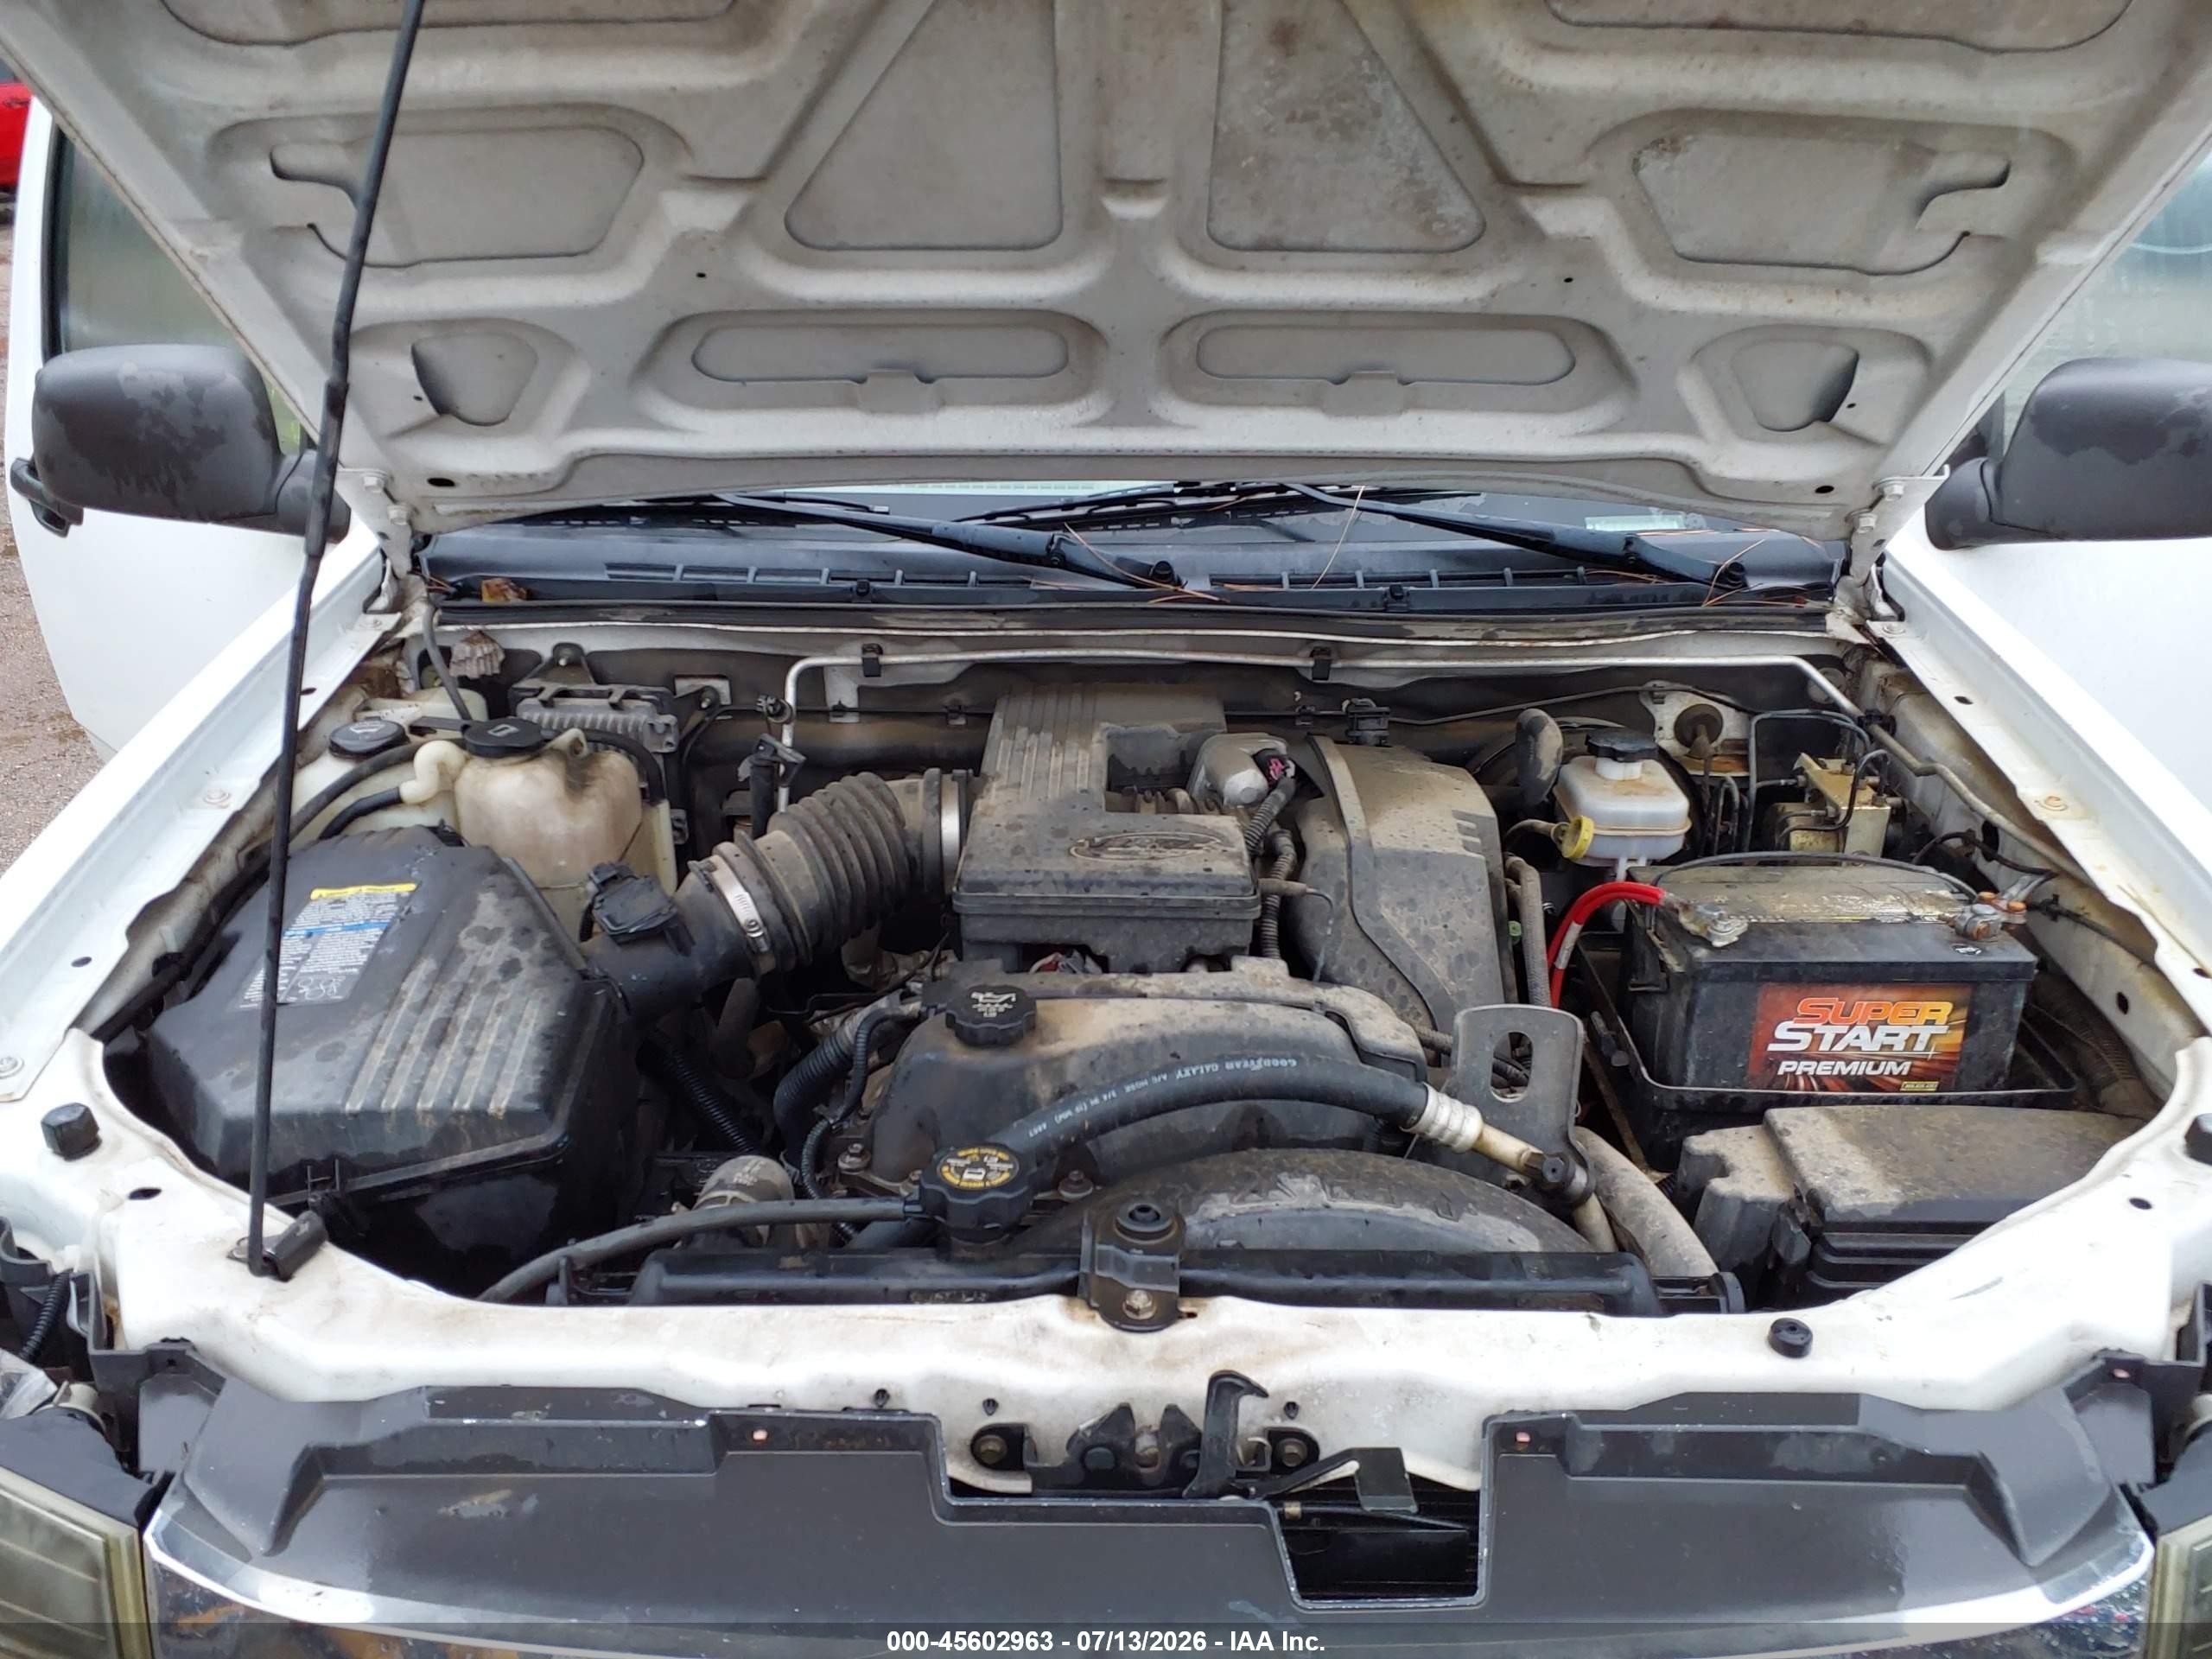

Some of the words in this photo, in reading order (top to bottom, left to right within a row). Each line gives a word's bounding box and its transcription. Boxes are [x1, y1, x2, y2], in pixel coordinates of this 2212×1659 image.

[1793, 997, 1954, 1025] SUPER
[1767, 1020, 1949, 1052] START
[1176, 1063, 1219, 1079] GALAXY
[1224, 1057, 1297, 1071] GOODYEAR
[1777, 1061, 1912, 1076] PREMIUM
